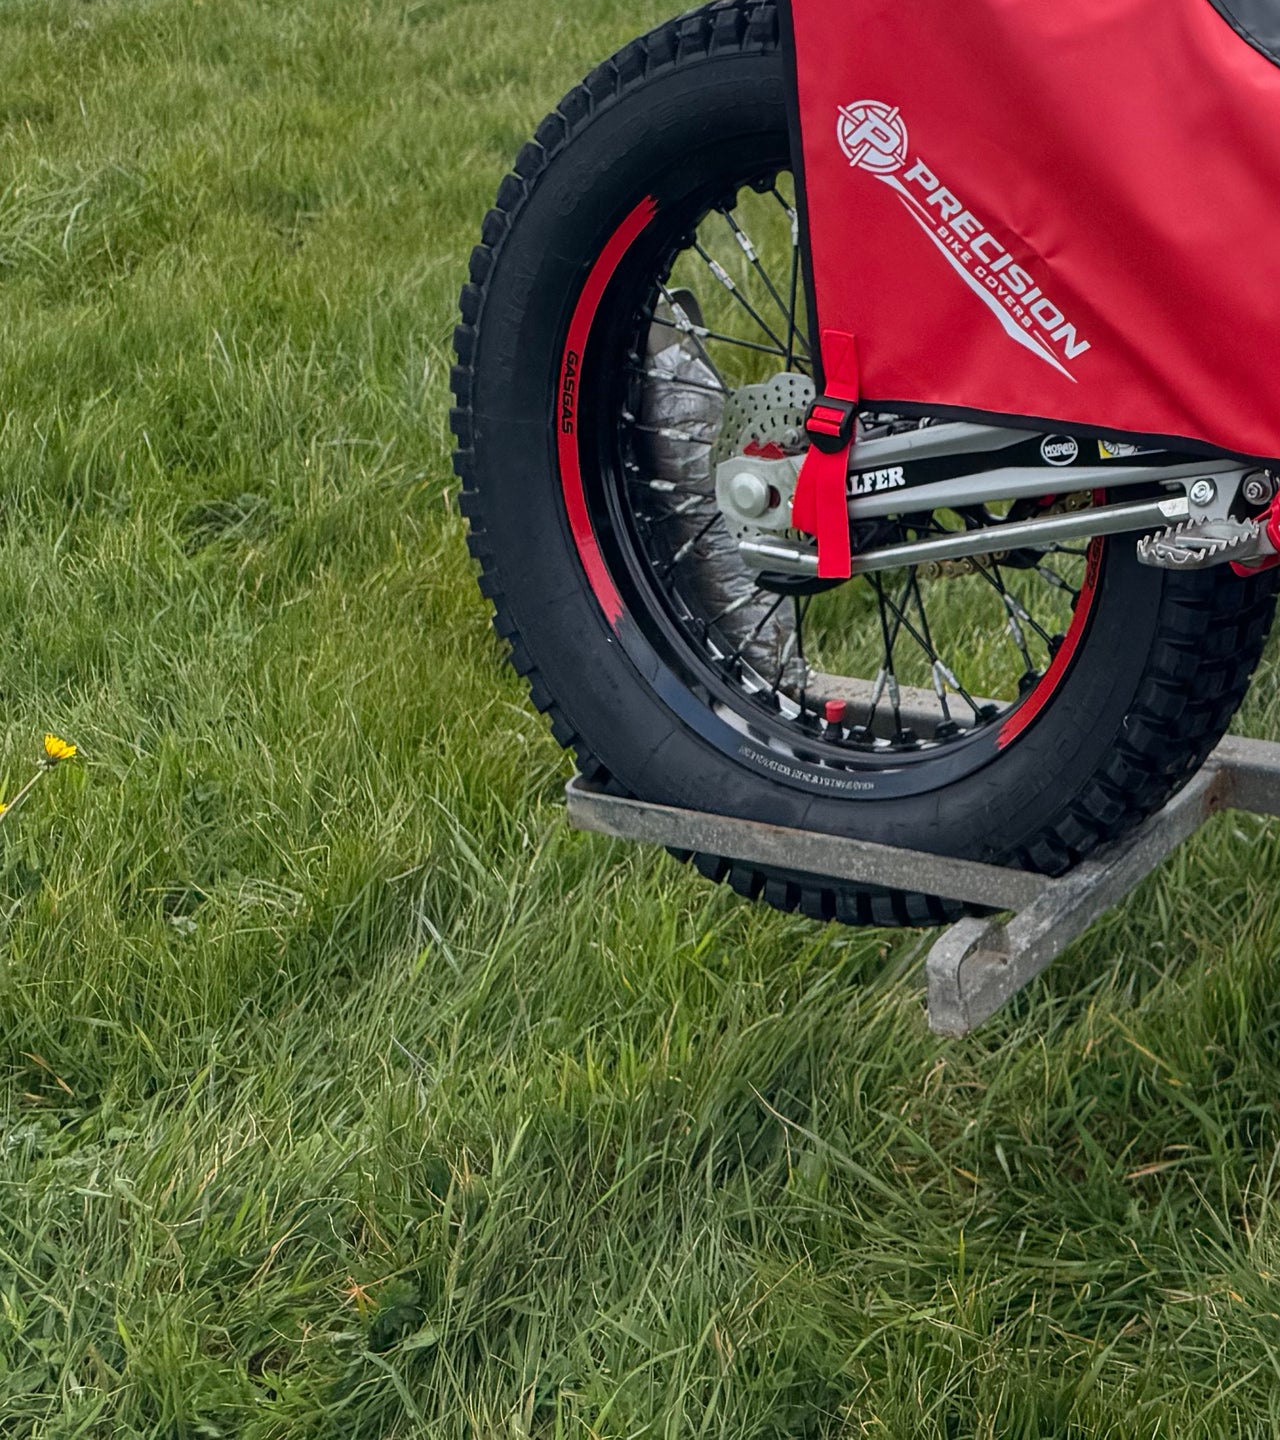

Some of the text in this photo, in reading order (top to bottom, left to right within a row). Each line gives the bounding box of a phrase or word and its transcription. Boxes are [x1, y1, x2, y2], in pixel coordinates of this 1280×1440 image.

[903, 157, 1091, 360] PRECISION
[936, 226, 1033, 329] BIKE COVERS
[561, 349, 579, 435] GASGAS
[846, 465, 906, 495] LFER
